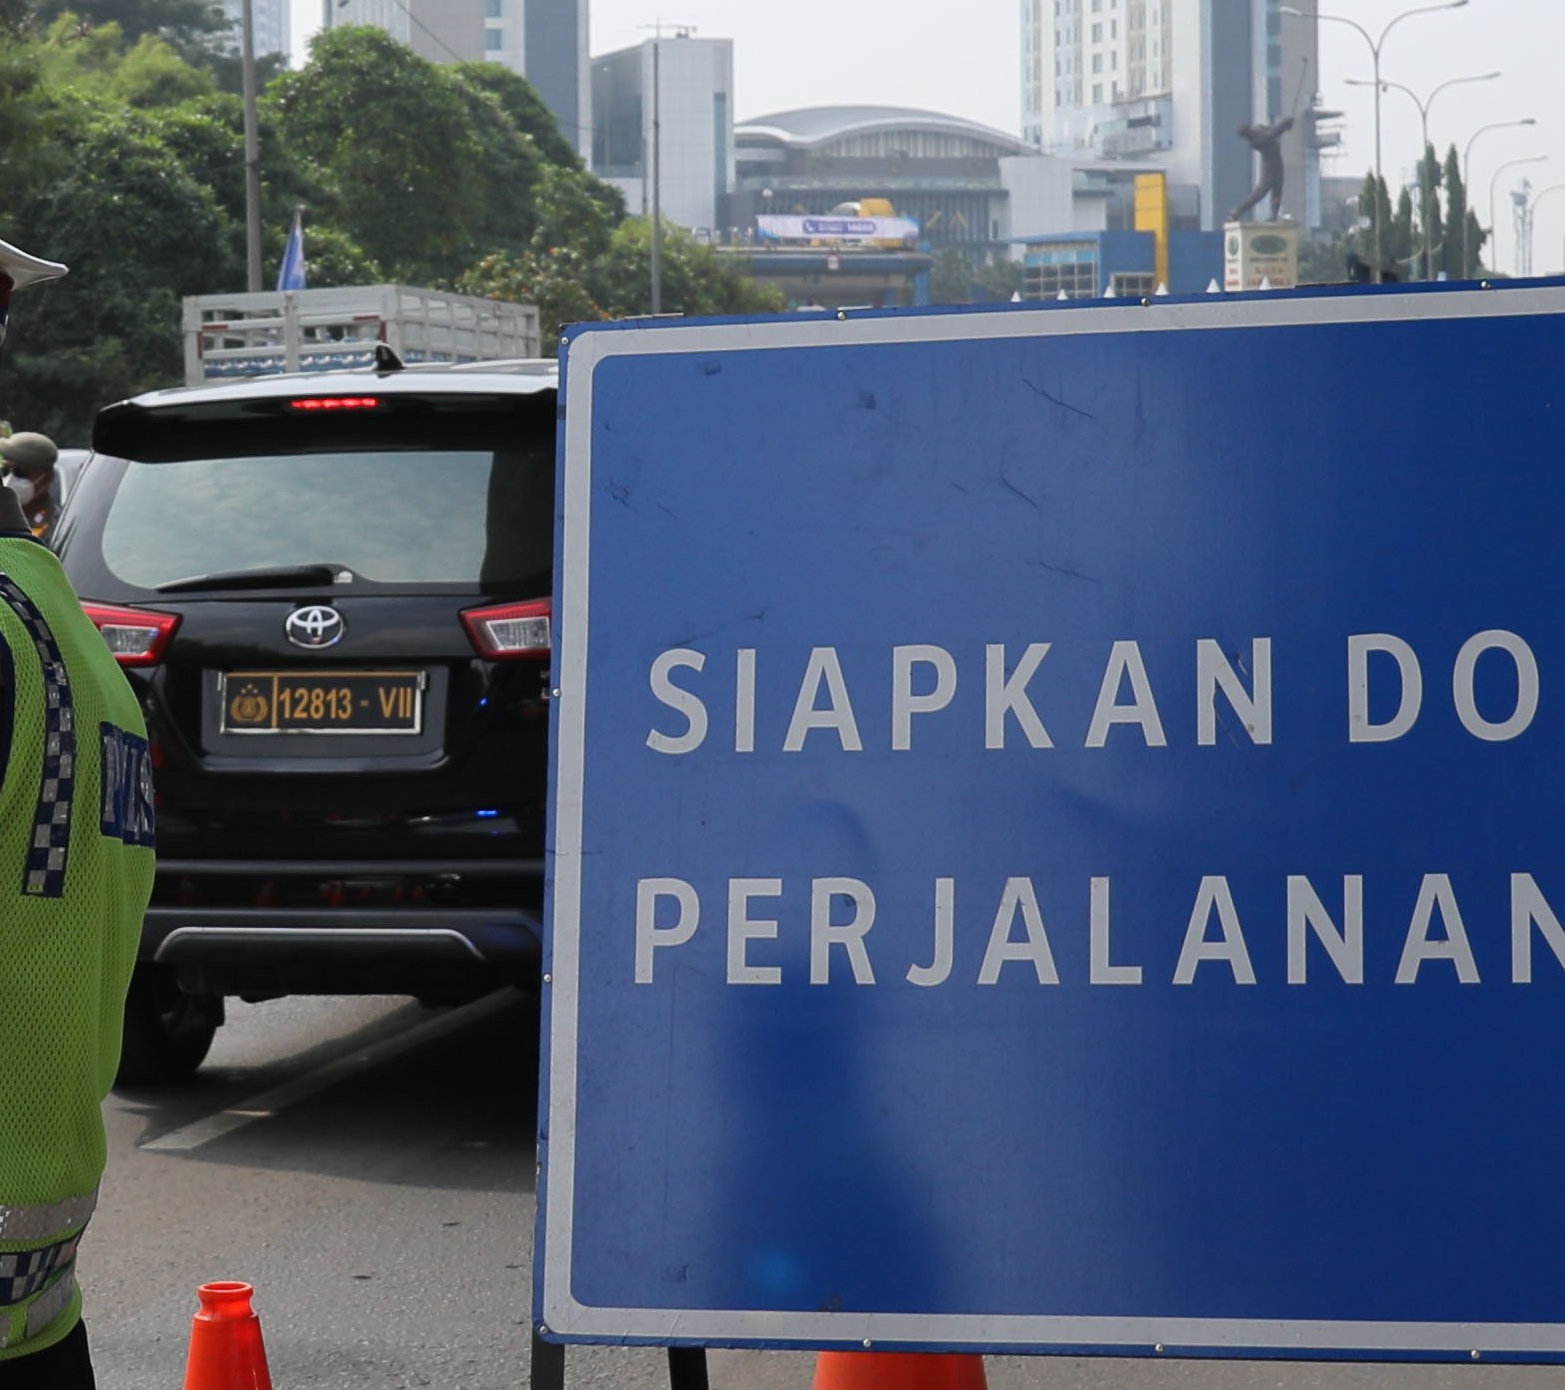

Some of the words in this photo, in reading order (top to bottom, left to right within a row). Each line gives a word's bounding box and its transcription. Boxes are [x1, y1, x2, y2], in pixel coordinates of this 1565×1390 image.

[279, 687, 352, 720] 12813
[378, 686, 413, 719] VII
[645, 636, 1272, 755] SIAPKAN
